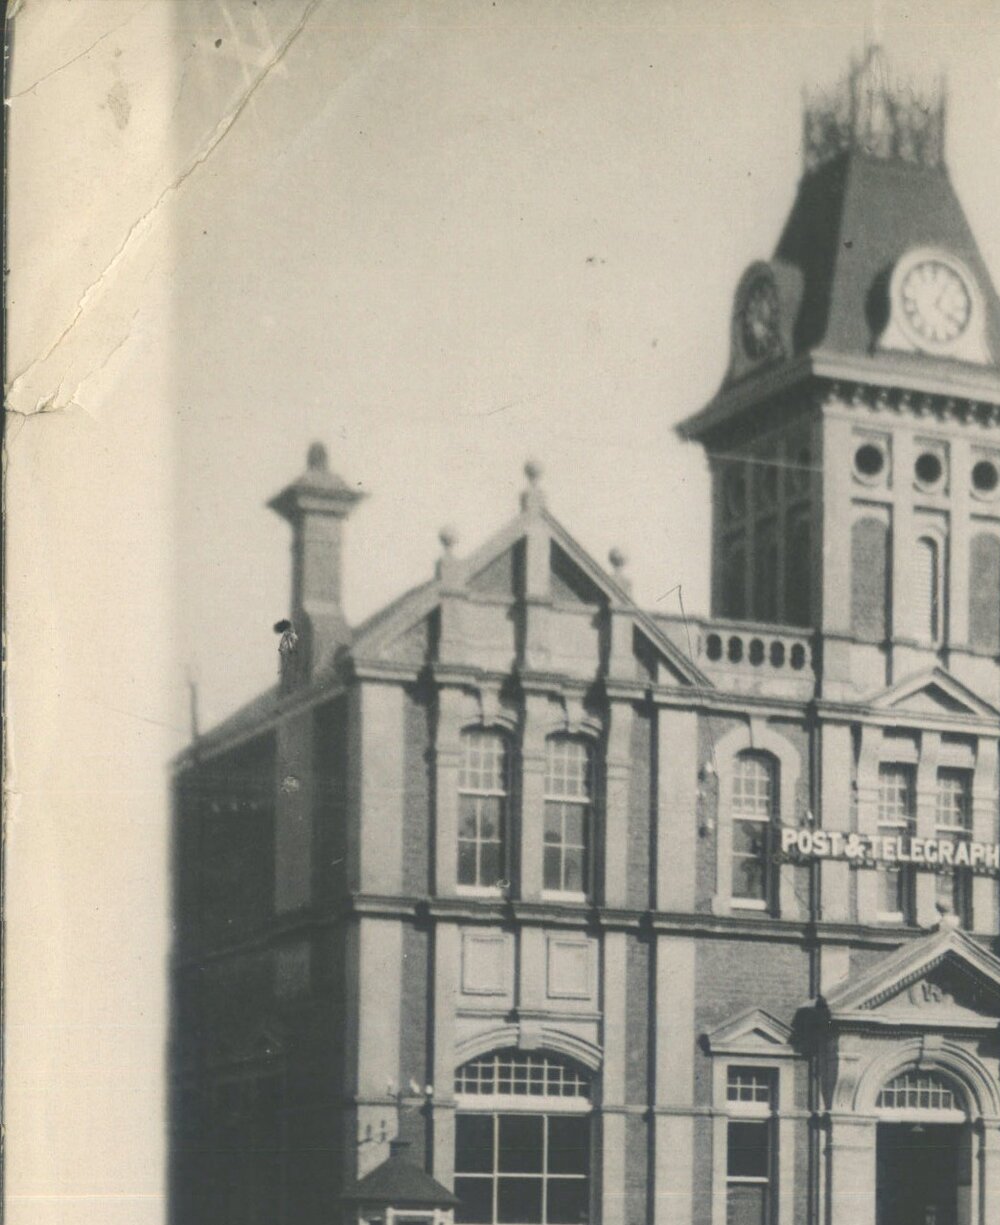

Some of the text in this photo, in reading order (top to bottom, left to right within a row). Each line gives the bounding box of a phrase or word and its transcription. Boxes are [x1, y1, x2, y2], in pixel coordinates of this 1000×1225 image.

[781, 828, 842, 857] POST
[845, 832, 867, 858] &
[867, 836, 1000, 867] TELEGRAPH
